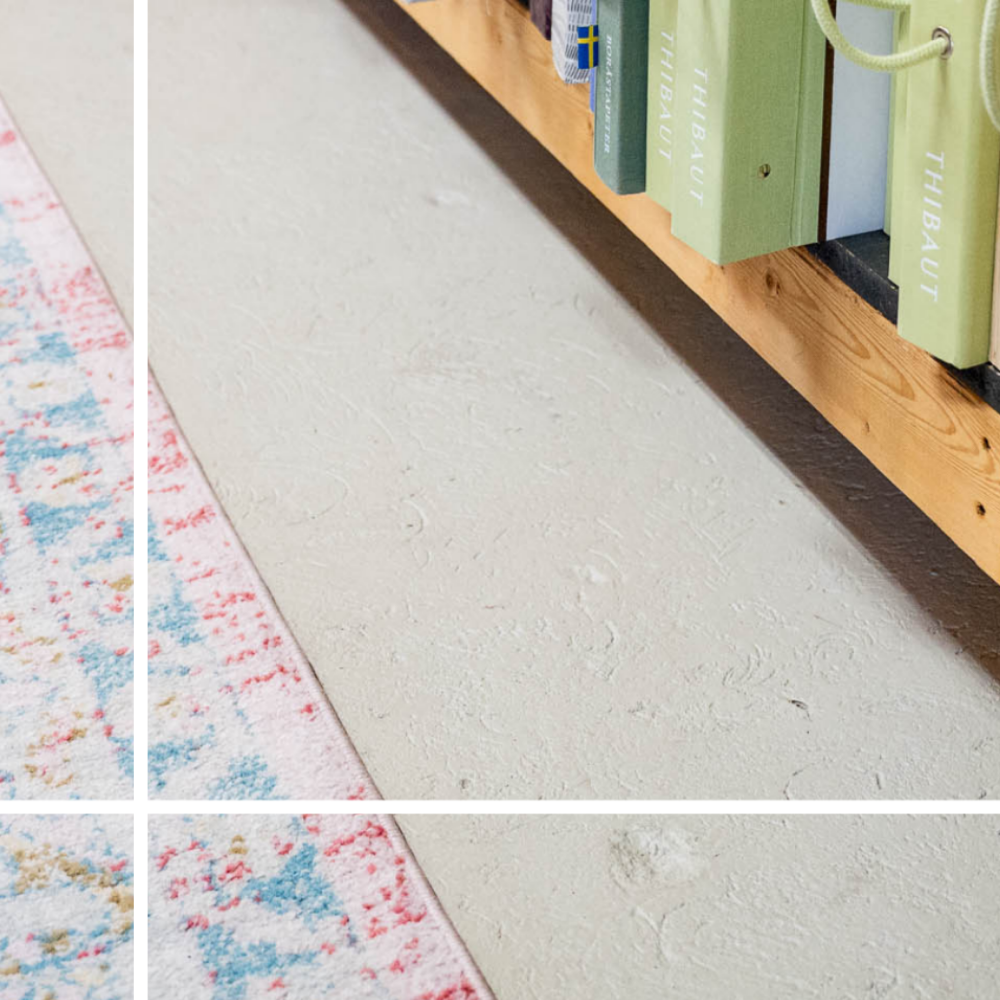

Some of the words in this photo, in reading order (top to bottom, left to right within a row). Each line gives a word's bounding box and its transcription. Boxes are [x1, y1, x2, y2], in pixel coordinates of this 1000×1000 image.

[603, 34, 613, 155] BORÅSTAPETER
[658, 29, 676, 164] THIBAUT
[688, 66, 709, 204] THIBAUT
[919, 150, 945, 304] THIBAUT
